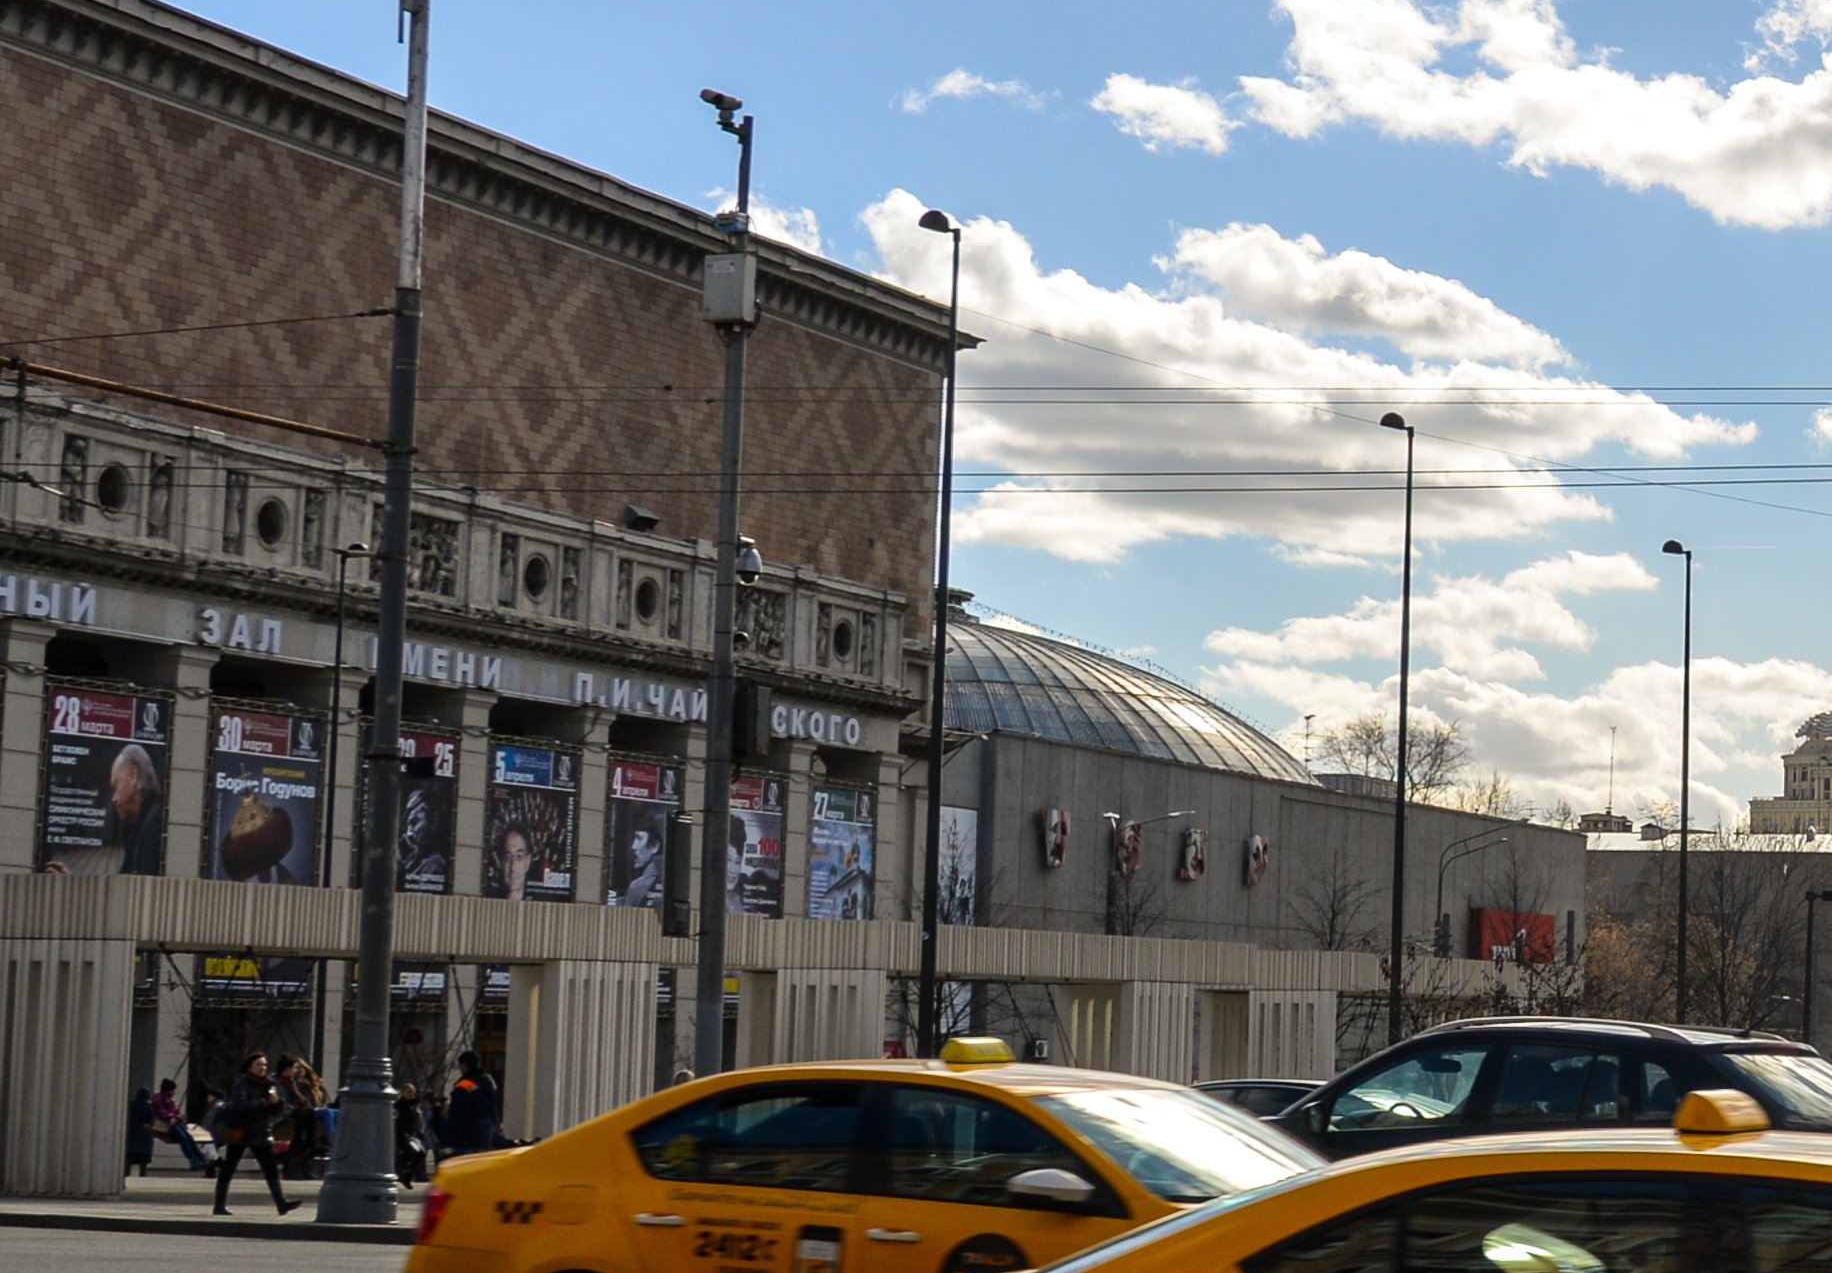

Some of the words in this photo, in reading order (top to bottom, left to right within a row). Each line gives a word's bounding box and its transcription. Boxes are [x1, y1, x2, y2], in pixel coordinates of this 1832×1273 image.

[201, 608, 282, 654] ЗАЛ
[373, 637, 501, 688] МЕНИ
[575, 672, 860, 744] П.И.ЧАЙСКОГО
[53, 695, 80, 733] 28
[81, 721, 115, 736] марта
[219, 715, 242, 751] 30
[242, 740, 273, 753] марта
[434, 742, 454, 776] 25
[495, 751, 506, 782] 5
[261, 777, 316, 799] Годунов
[612, 766, 622, 797] 4
[814, 792, 829, 819] 27
[758, 837, 779, 857] 100
